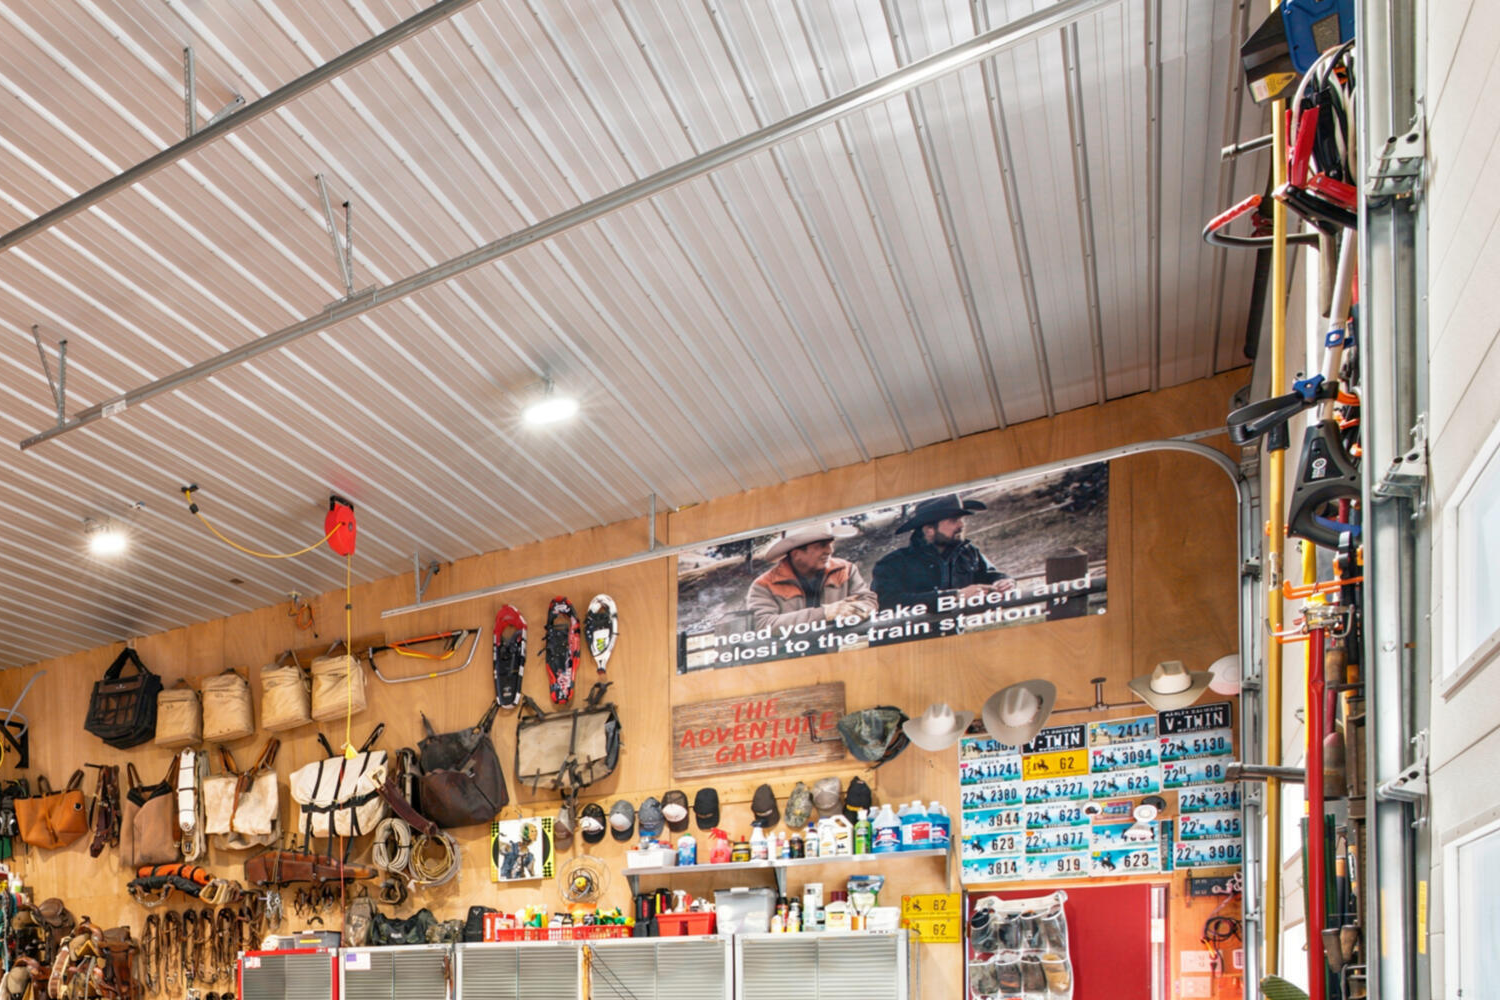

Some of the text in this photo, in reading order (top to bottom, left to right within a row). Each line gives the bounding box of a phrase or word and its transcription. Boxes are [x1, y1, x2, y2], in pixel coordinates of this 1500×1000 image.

[714, 625, 771, 647] need
[779, 619, 826, 640] you
[835, 613, 860, 628] to
[869, 605, 927, 624] take
[937, 590, 1022, 612] Biden
[1033, 573, 1091, 597] and
[704, 641, 777, 665] Pelosi
[785, 639, 810, 653] to
[818, 631, 858, 648] the
[867, 620, 929, 642] train
[732, 698, 780, 723] THE
[680, 711, 835, 749] ADVENTURE
[1118, 722, 1149, 738] 2414
[715, 738, 797, 764] CABIN
[1161, 736, 1224, 757] 22 5130
[1122, 749, 1152, 765] 3094
[962, 767, 974, 779] 12
[987, 762, 1019, 778] 11241
[1164, 770, 1179, 782] 22
[1205, 764, 1220, 778] 88
[1025, 782, 1083, 800] 22 3227
[1093, 776, 1150, 793] 22 623
[963, 788, 1017, 805] 22 2380
[1181, 794, 1195, 807] 22
[989, 812, 1020, 827] 3944
[1027, 808, 1081, 825] 22 623
[1181, 818, 1239, 833] 22 435
[991, 837, 1014, 851] 623
[1026, 832, 1083, 848] 22 1977
[1124, 853, 1149, 868] 623
[1176, 845, 1241, 860] 22 3902
[988, 861, 1017, 876] 3814
[1058, 859, 1081, 872] 919
[933, 900, 947, 911] 62
[933, 924, 947, 935] 62
